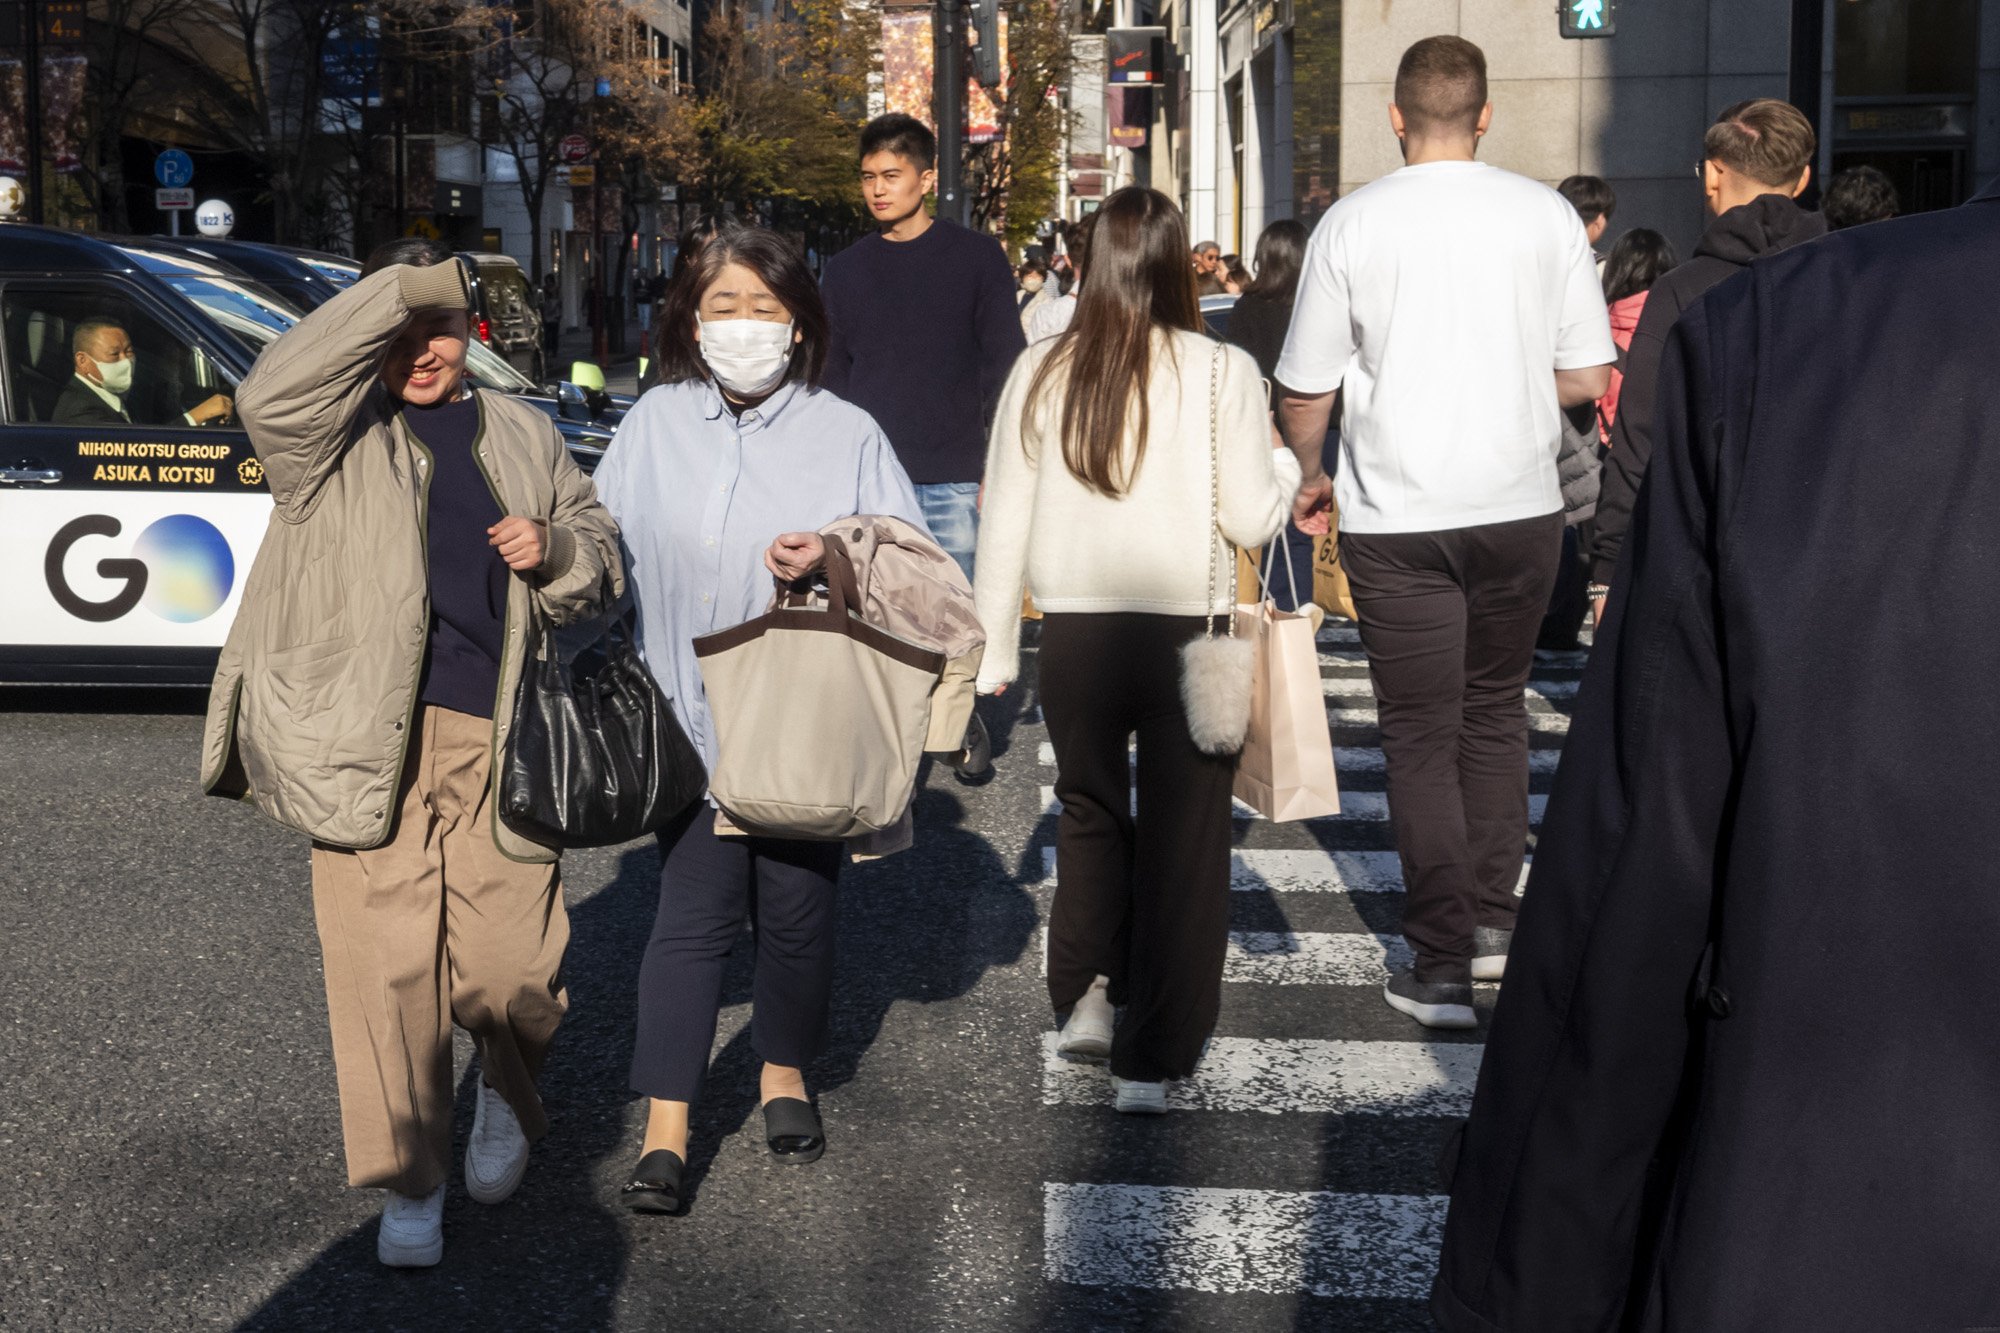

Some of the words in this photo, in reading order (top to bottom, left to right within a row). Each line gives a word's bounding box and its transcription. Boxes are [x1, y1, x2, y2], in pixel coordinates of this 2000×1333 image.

[78, 442, 125, 457] NIHON
[127, 443, 175, 458] KOTSU
[178, 444, 231, 459] GROUP
[93, 465, 151, 482] ASUKA
[158, 466, 215, 484] KOTSU
[44, 513, 235, 624] GO
